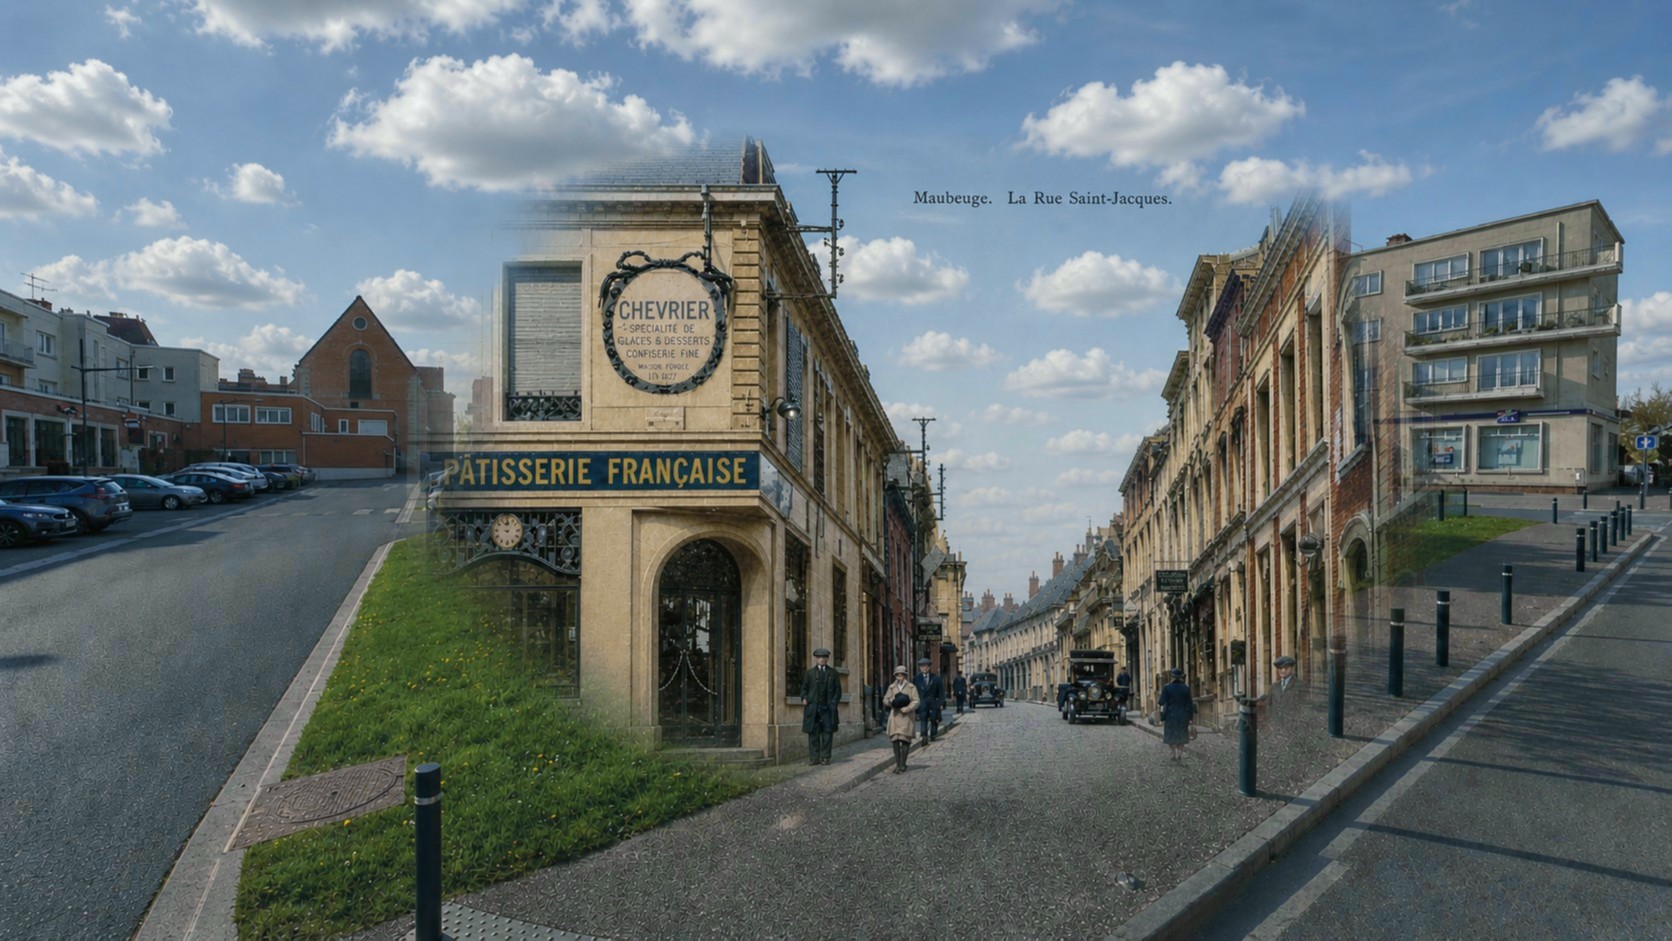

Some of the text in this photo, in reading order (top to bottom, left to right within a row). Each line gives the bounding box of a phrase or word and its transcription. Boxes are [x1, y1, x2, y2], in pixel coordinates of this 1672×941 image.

[619, 301, 710, 320] CHEVRIER
[683, 324, 695, 334] DE
[617, 336, 652, 346] GLACES
[664, 336, 711, 346] DESSERTS
[626, 349, 700, 359] CONFISERIE FINE
[444, 454, 747, 489] PÂTISSERIE FRANÇAISE
